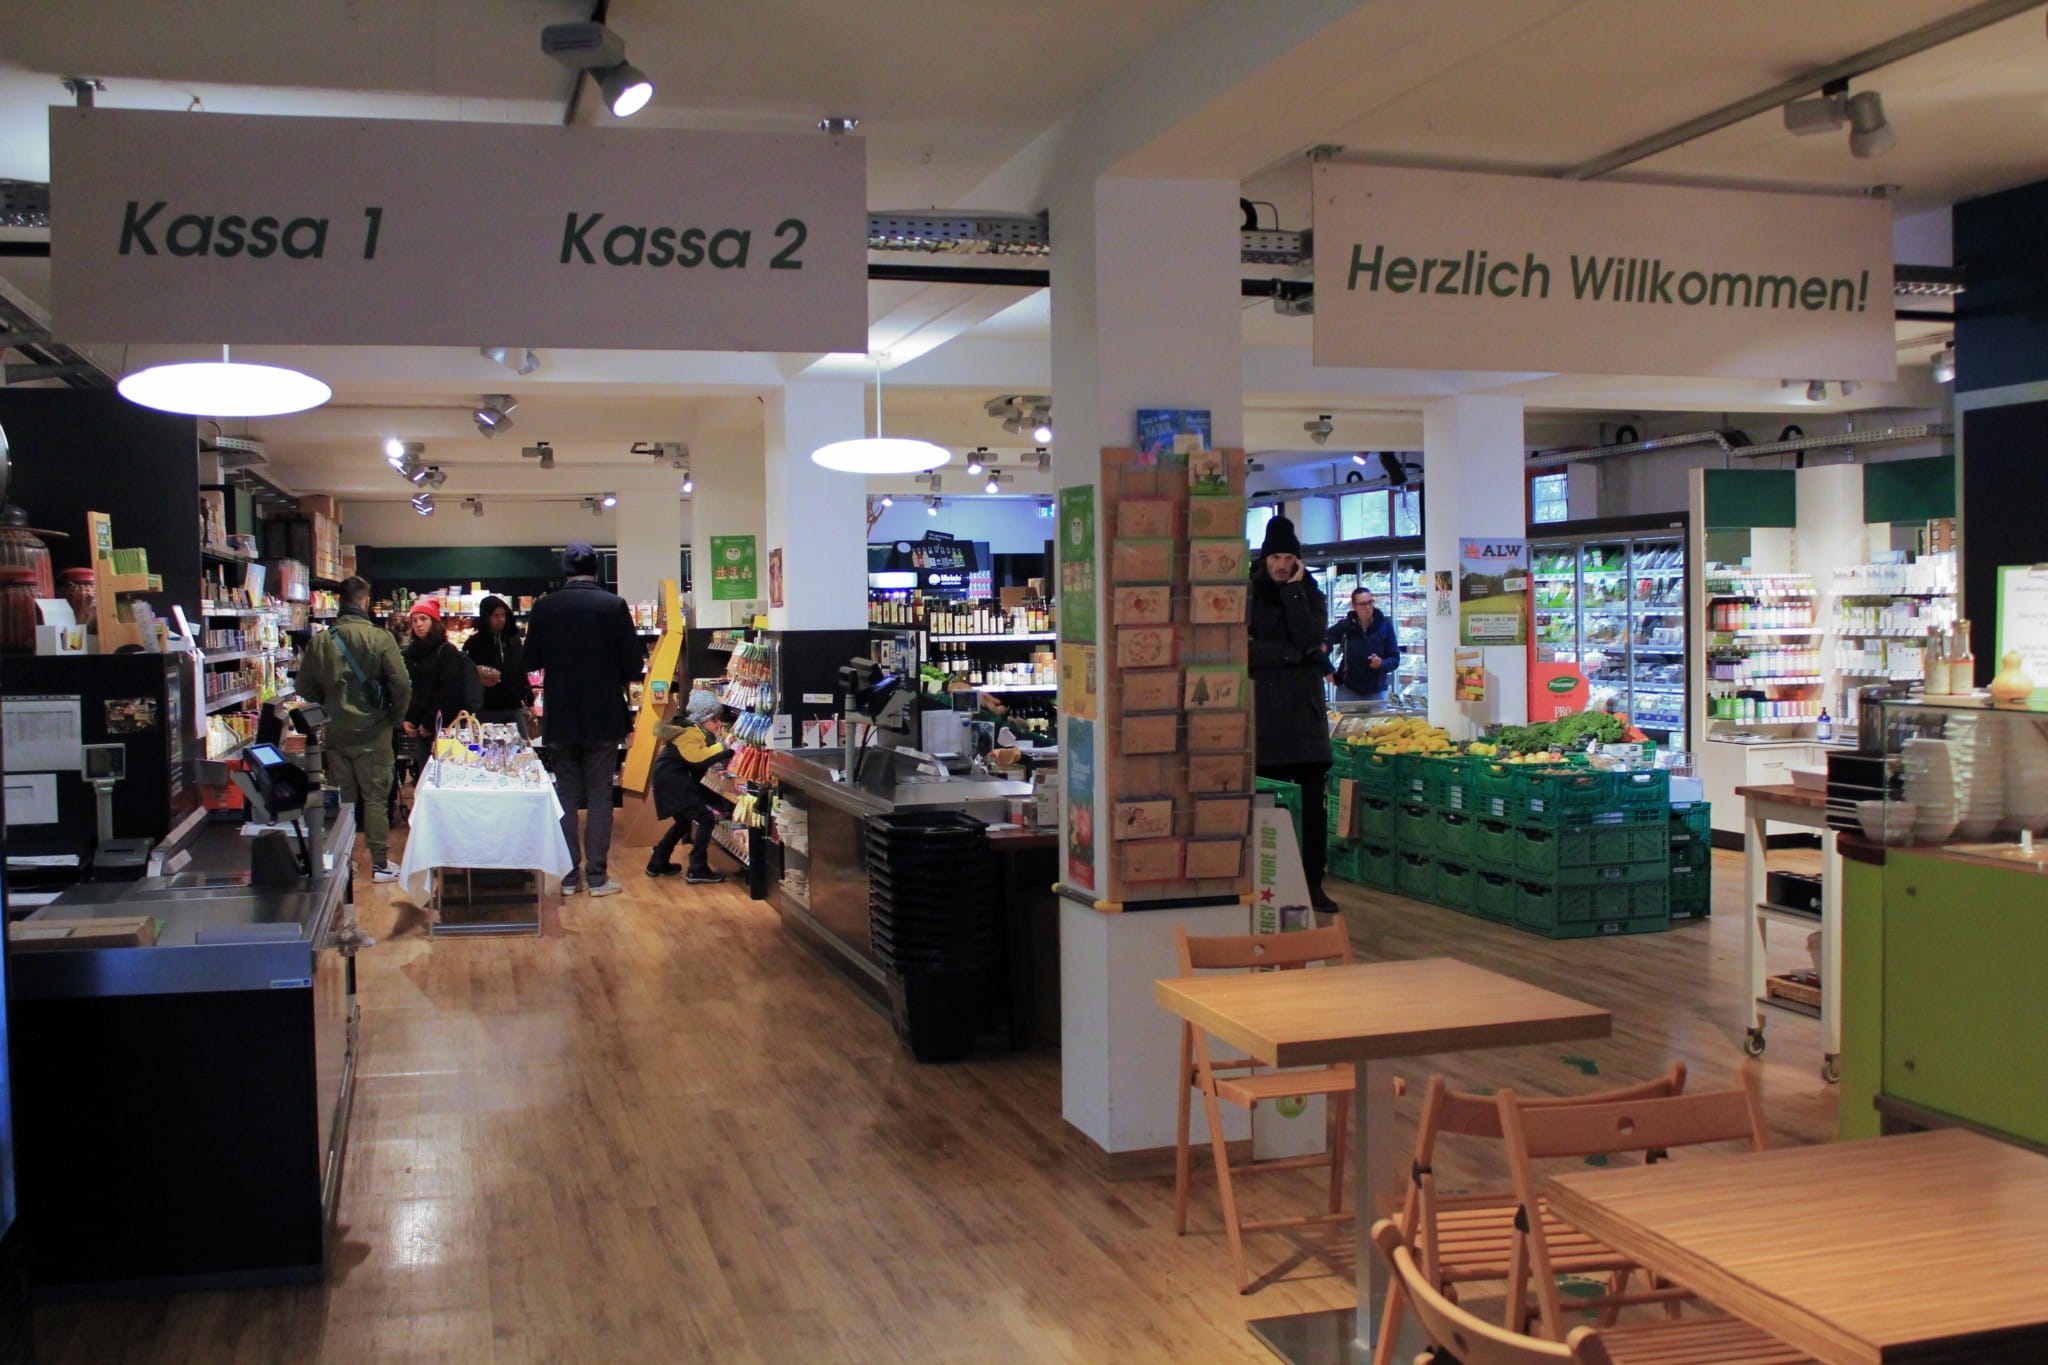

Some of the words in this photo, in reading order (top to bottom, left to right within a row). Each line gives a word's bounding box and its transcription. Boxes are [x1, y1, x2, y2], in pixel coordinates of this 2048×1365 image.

[118, 200, 329, 261] Kassa
[361, 205, 387, 261] 1
[559, 210, 752, 270] Kassa
[768, 217, 808, 271] 2
[1346, 243, 1551, 299] Herzlich
[1569, 254, 1870, 313] Willkommen!
[1481, 544, 1522, 557] ALW
[1260, 853, 1278, 885] PURE
[1259, 903, 1276, 935] ERGY
